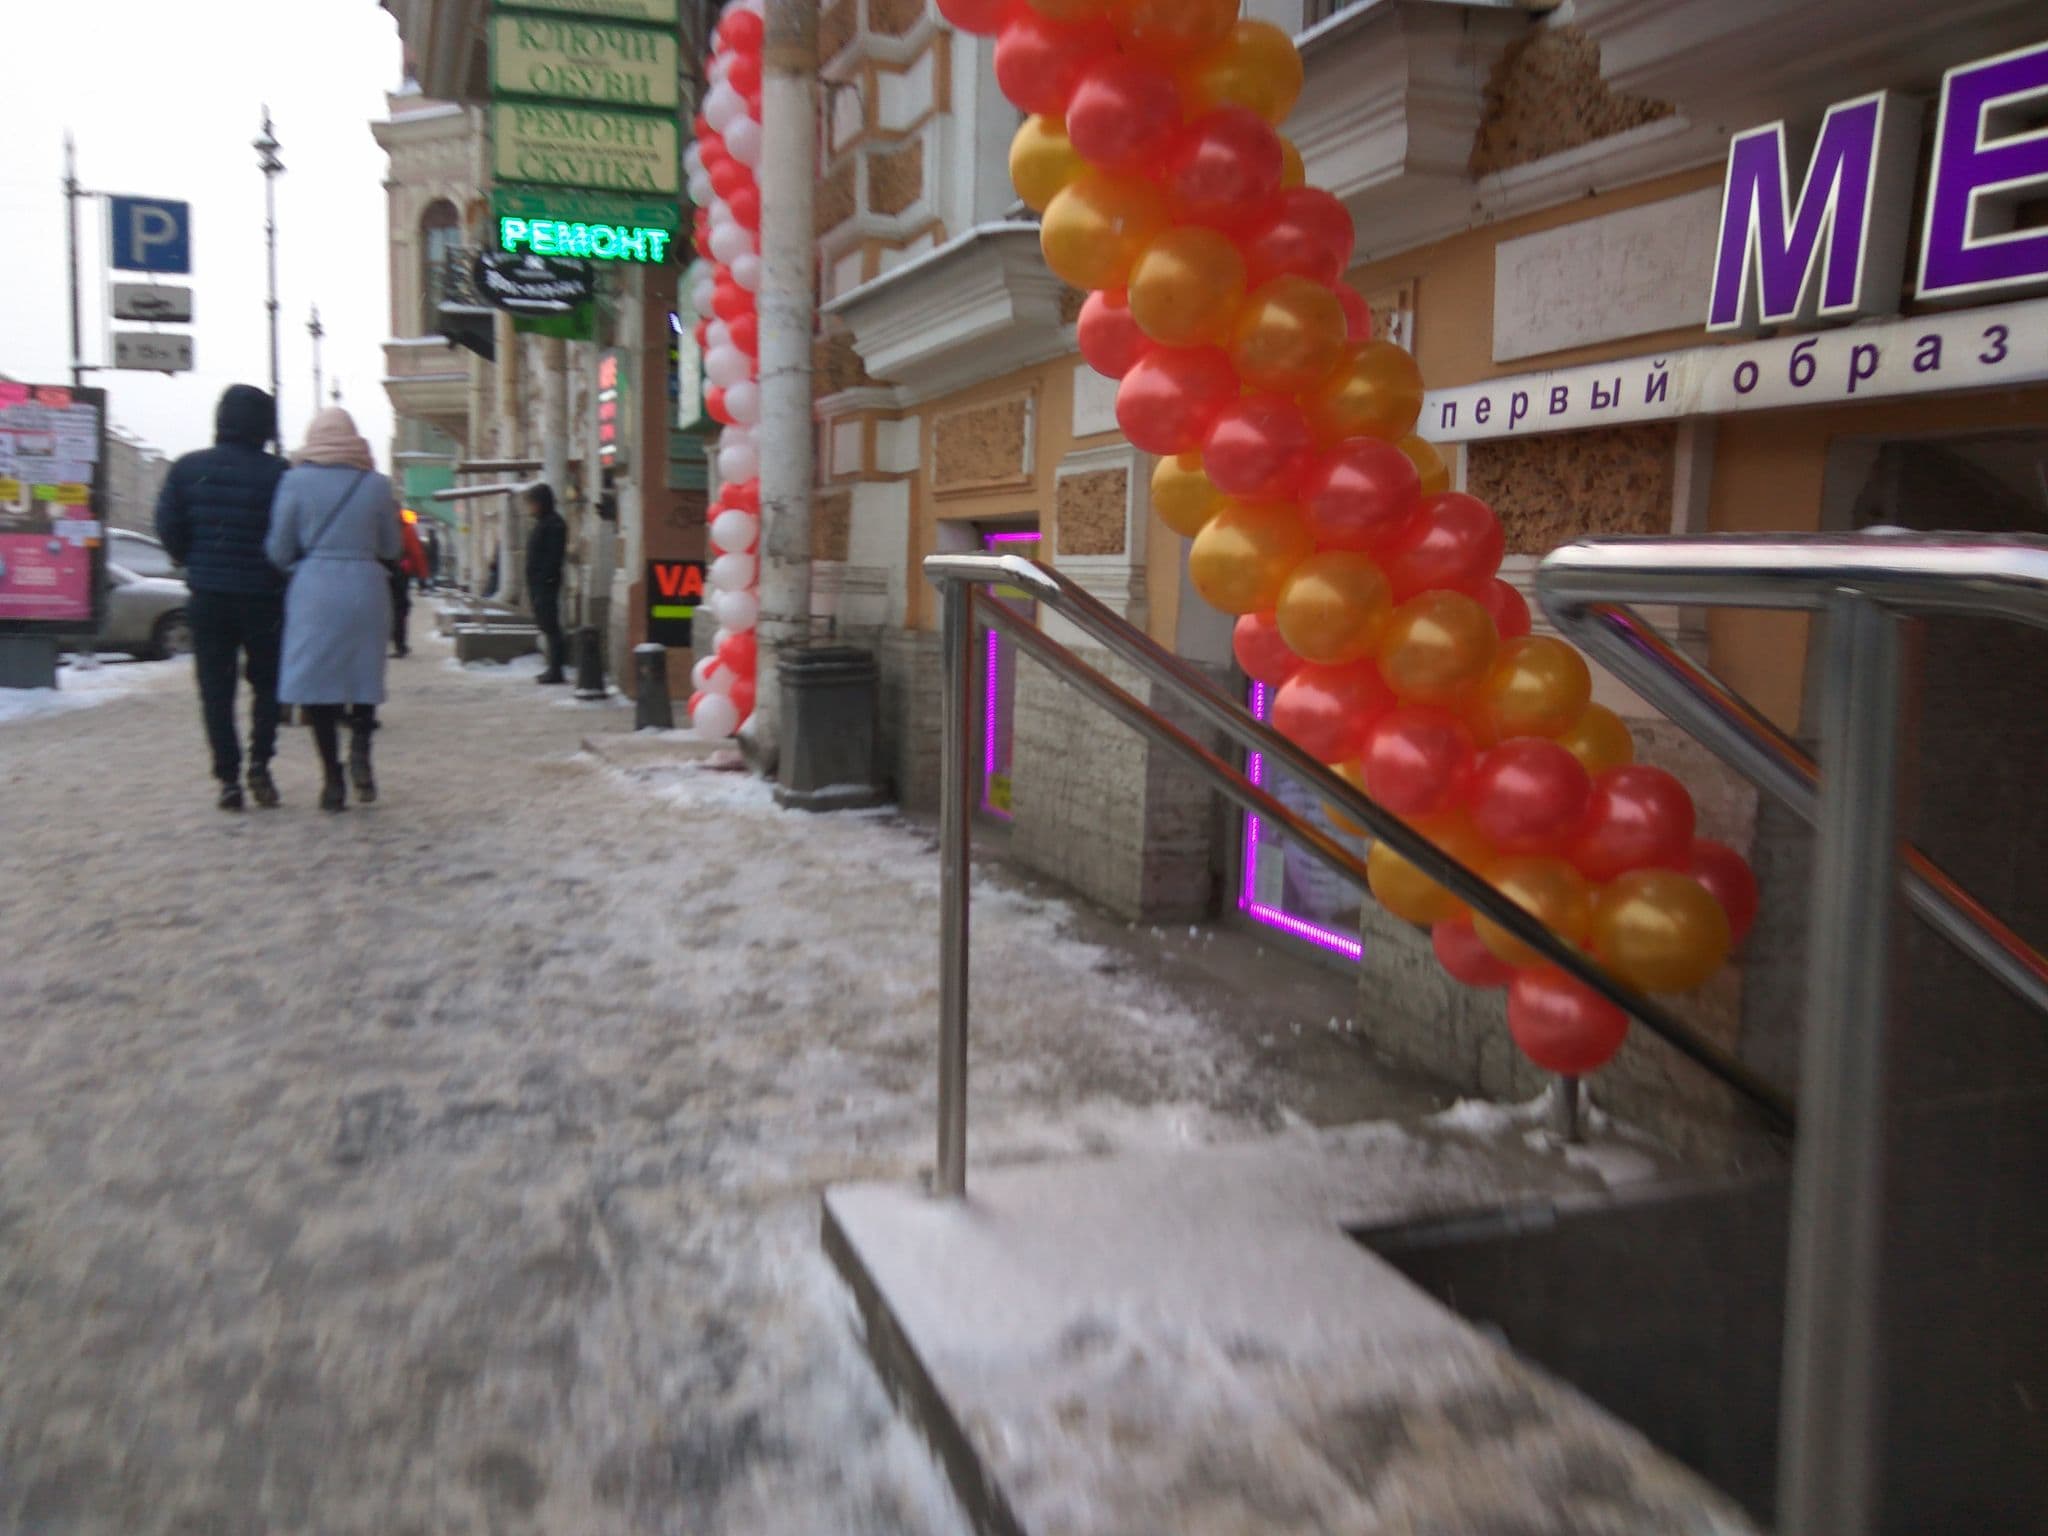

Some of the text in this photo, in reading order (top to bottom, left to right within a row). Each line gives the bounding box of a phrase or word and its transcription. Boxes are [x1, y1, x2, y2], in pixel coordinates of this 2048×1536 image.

[517, 21, 657, 62] КЛЮЧИ
[528, 64, 652, 104] ОБУВИ
[515, 108, 661, 146] РЕМОНТ
[517, 151, 658, 190] СКУПКА
[129, 203, 178, 264] P
[501, 216, 670, 263] РЕМОНТ
[1440, 324, 2010, 430] первый образ
